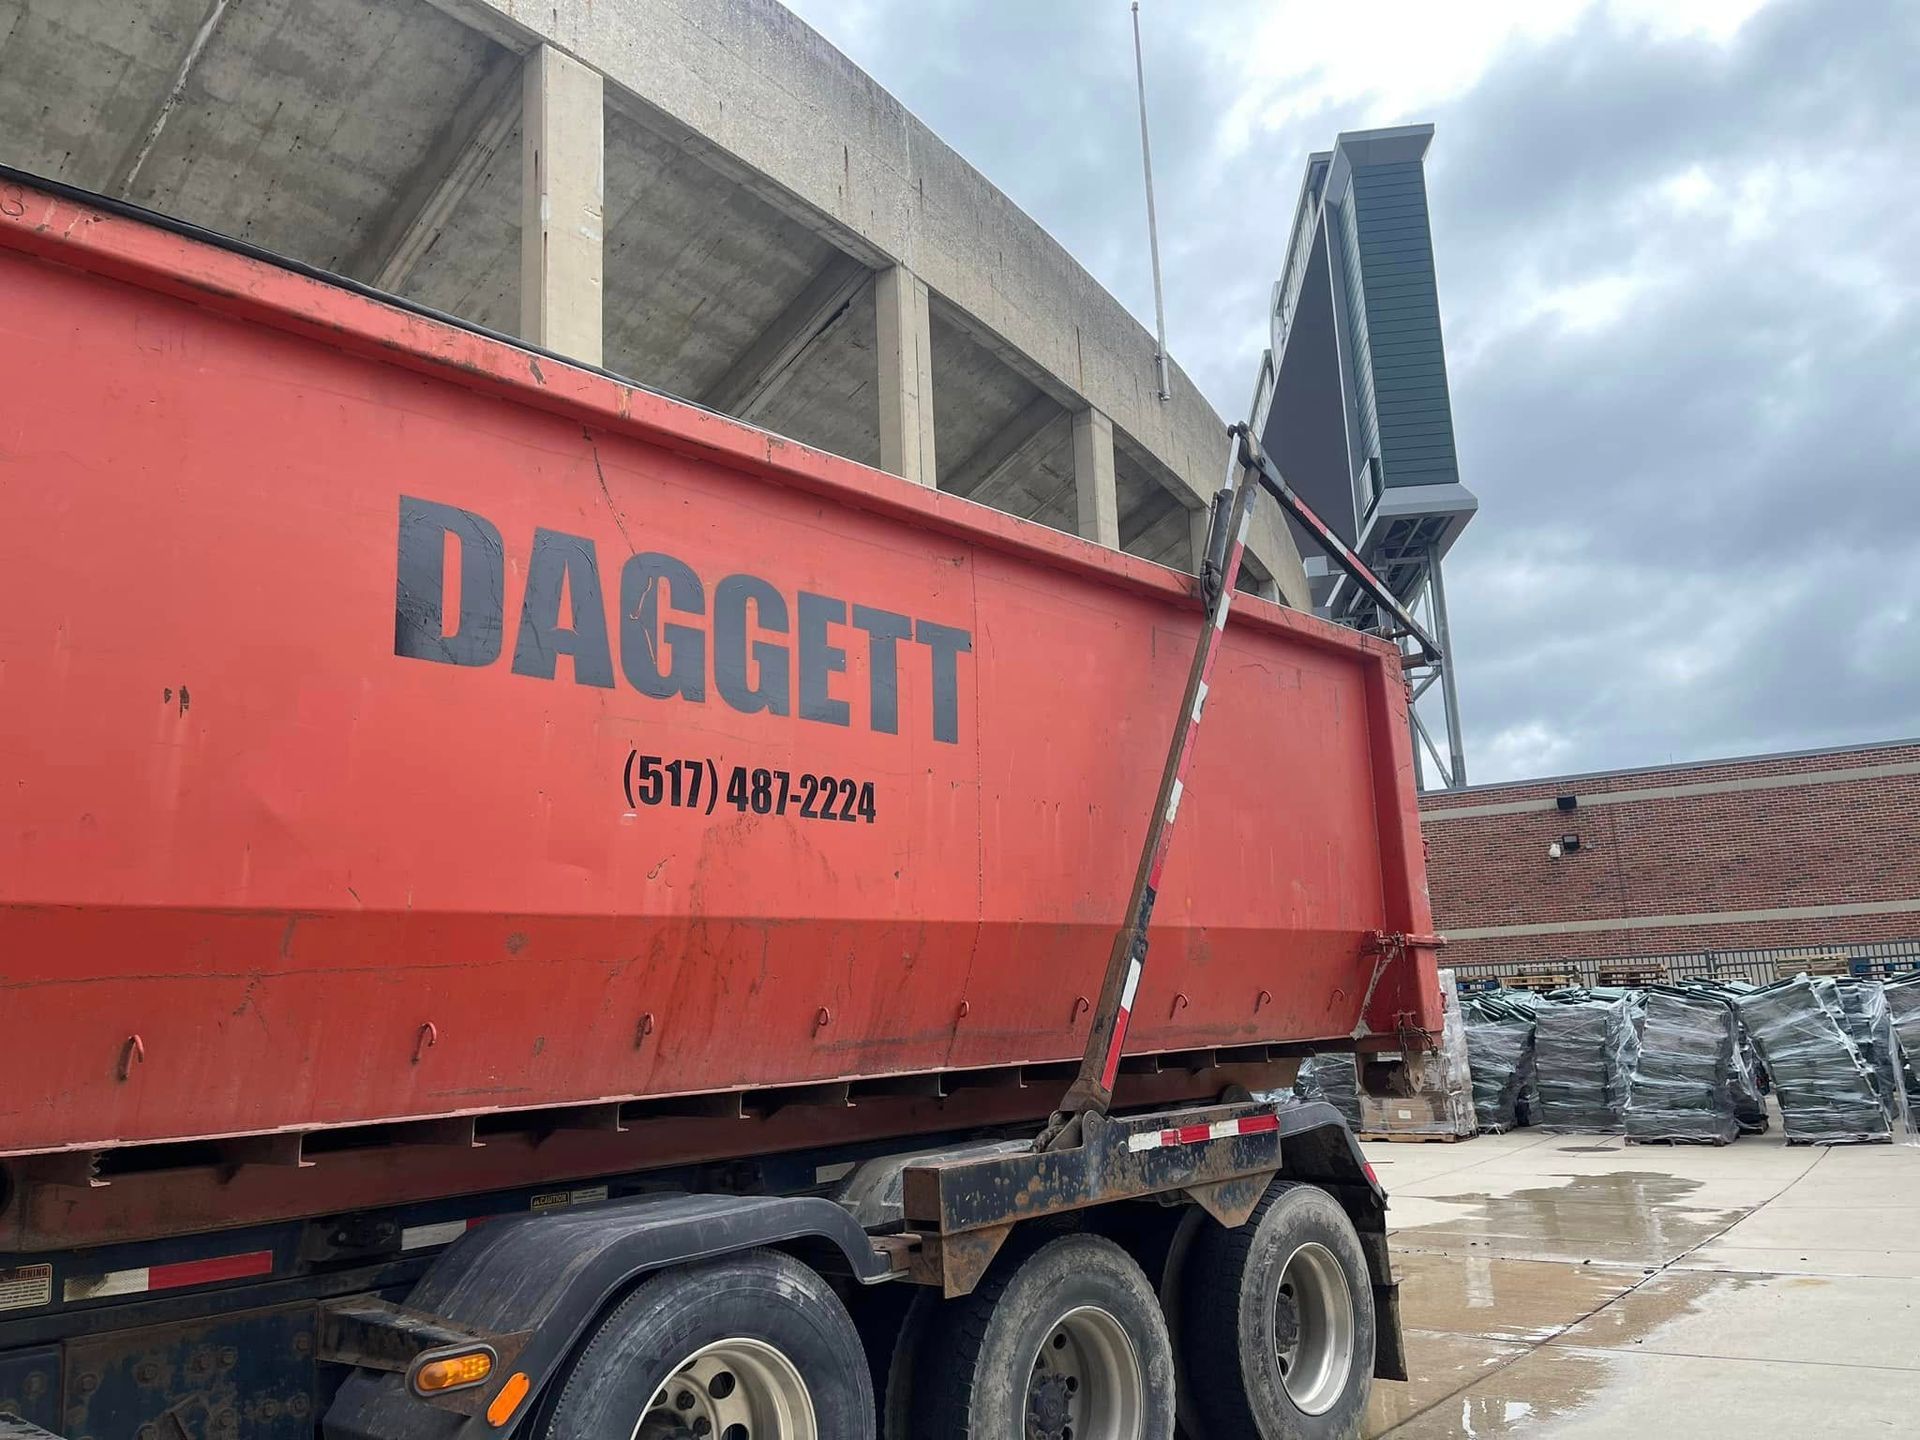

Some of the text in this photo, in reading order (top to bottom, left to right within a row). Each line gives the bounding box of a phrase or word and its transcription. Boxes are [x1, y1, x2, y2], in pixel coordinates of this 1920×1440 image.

[394, 495, 972, 744] DAGGETT
[623, 749, 876, 823] (517) 487-2224
[540, 1194, 567, 1205] CAUTION
[10, 1267, 49, 1280] ARNING
